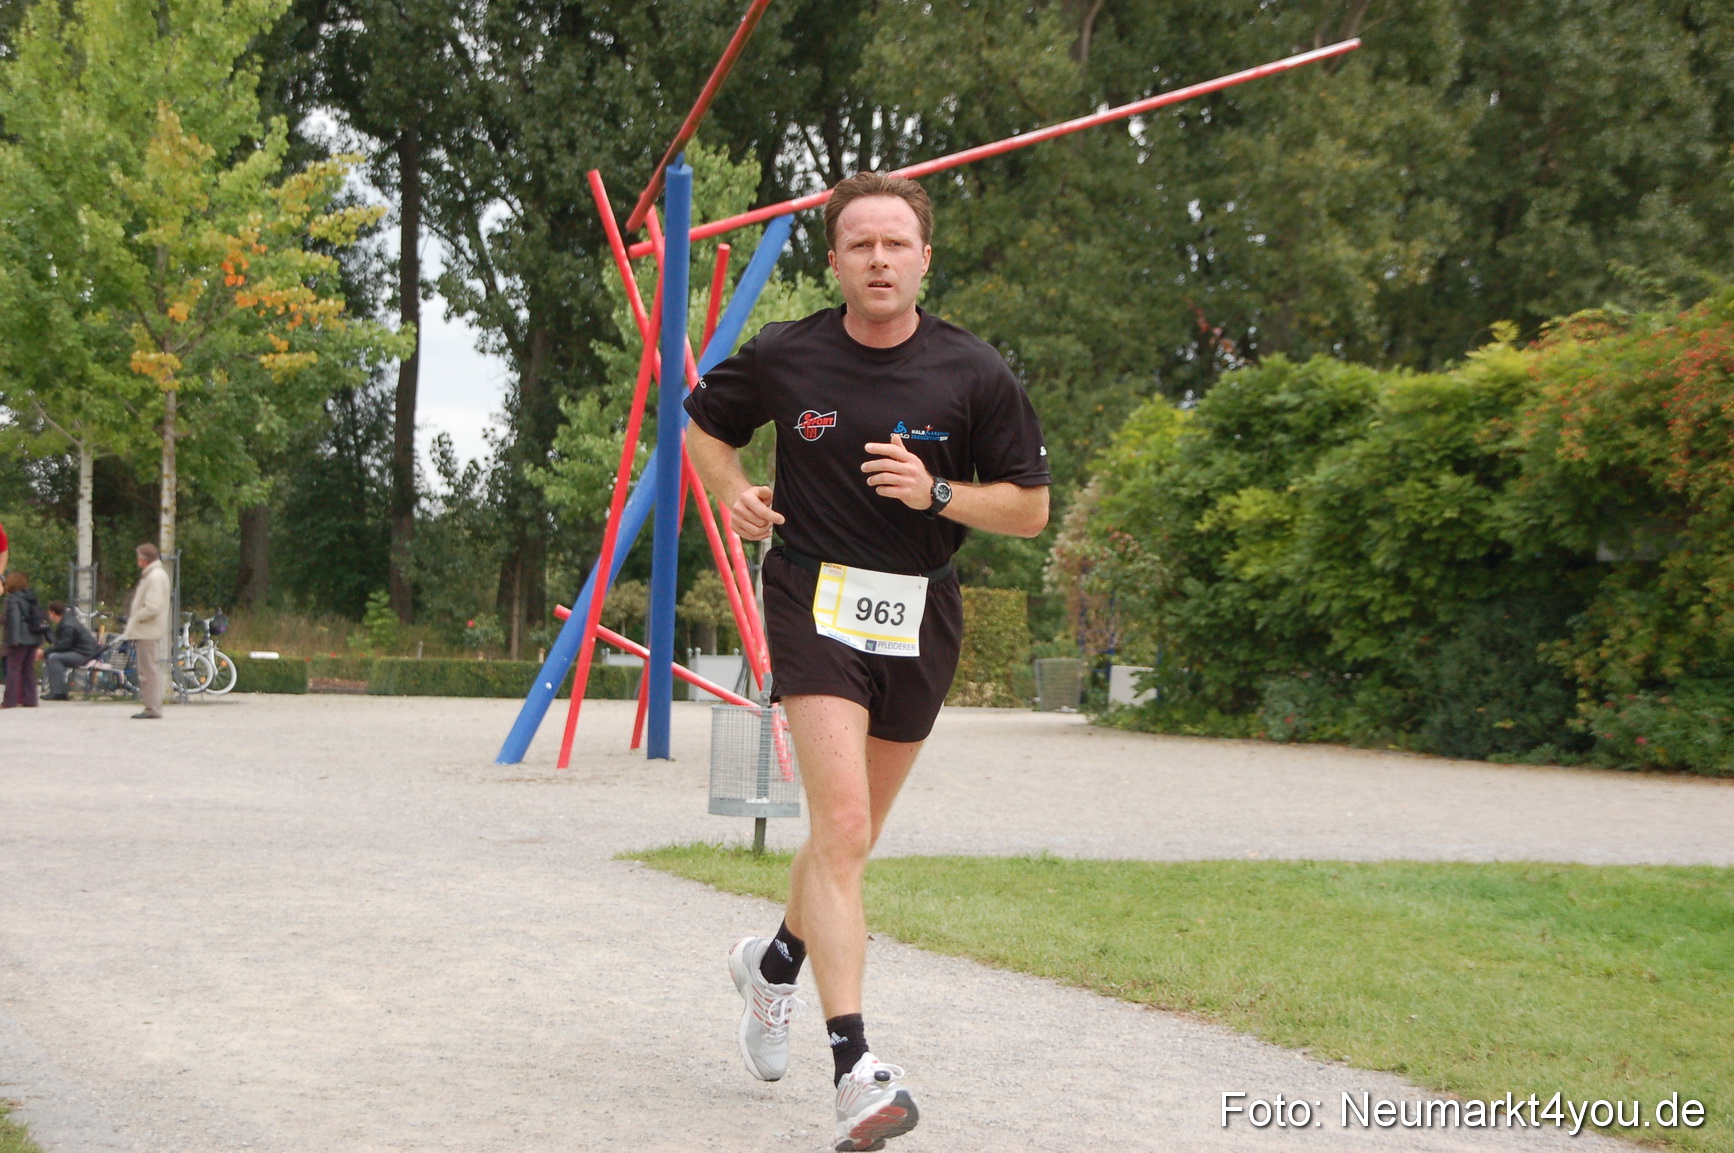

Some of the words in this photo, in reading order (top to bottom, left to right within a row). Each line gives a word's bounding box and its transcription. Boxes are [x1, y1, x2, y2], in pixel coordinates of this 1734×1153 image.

[802, 413, 834, 426] SPORT
[855, 597, 906, 626] 963
[877, 640, 917, 651] PFLEIDERER
